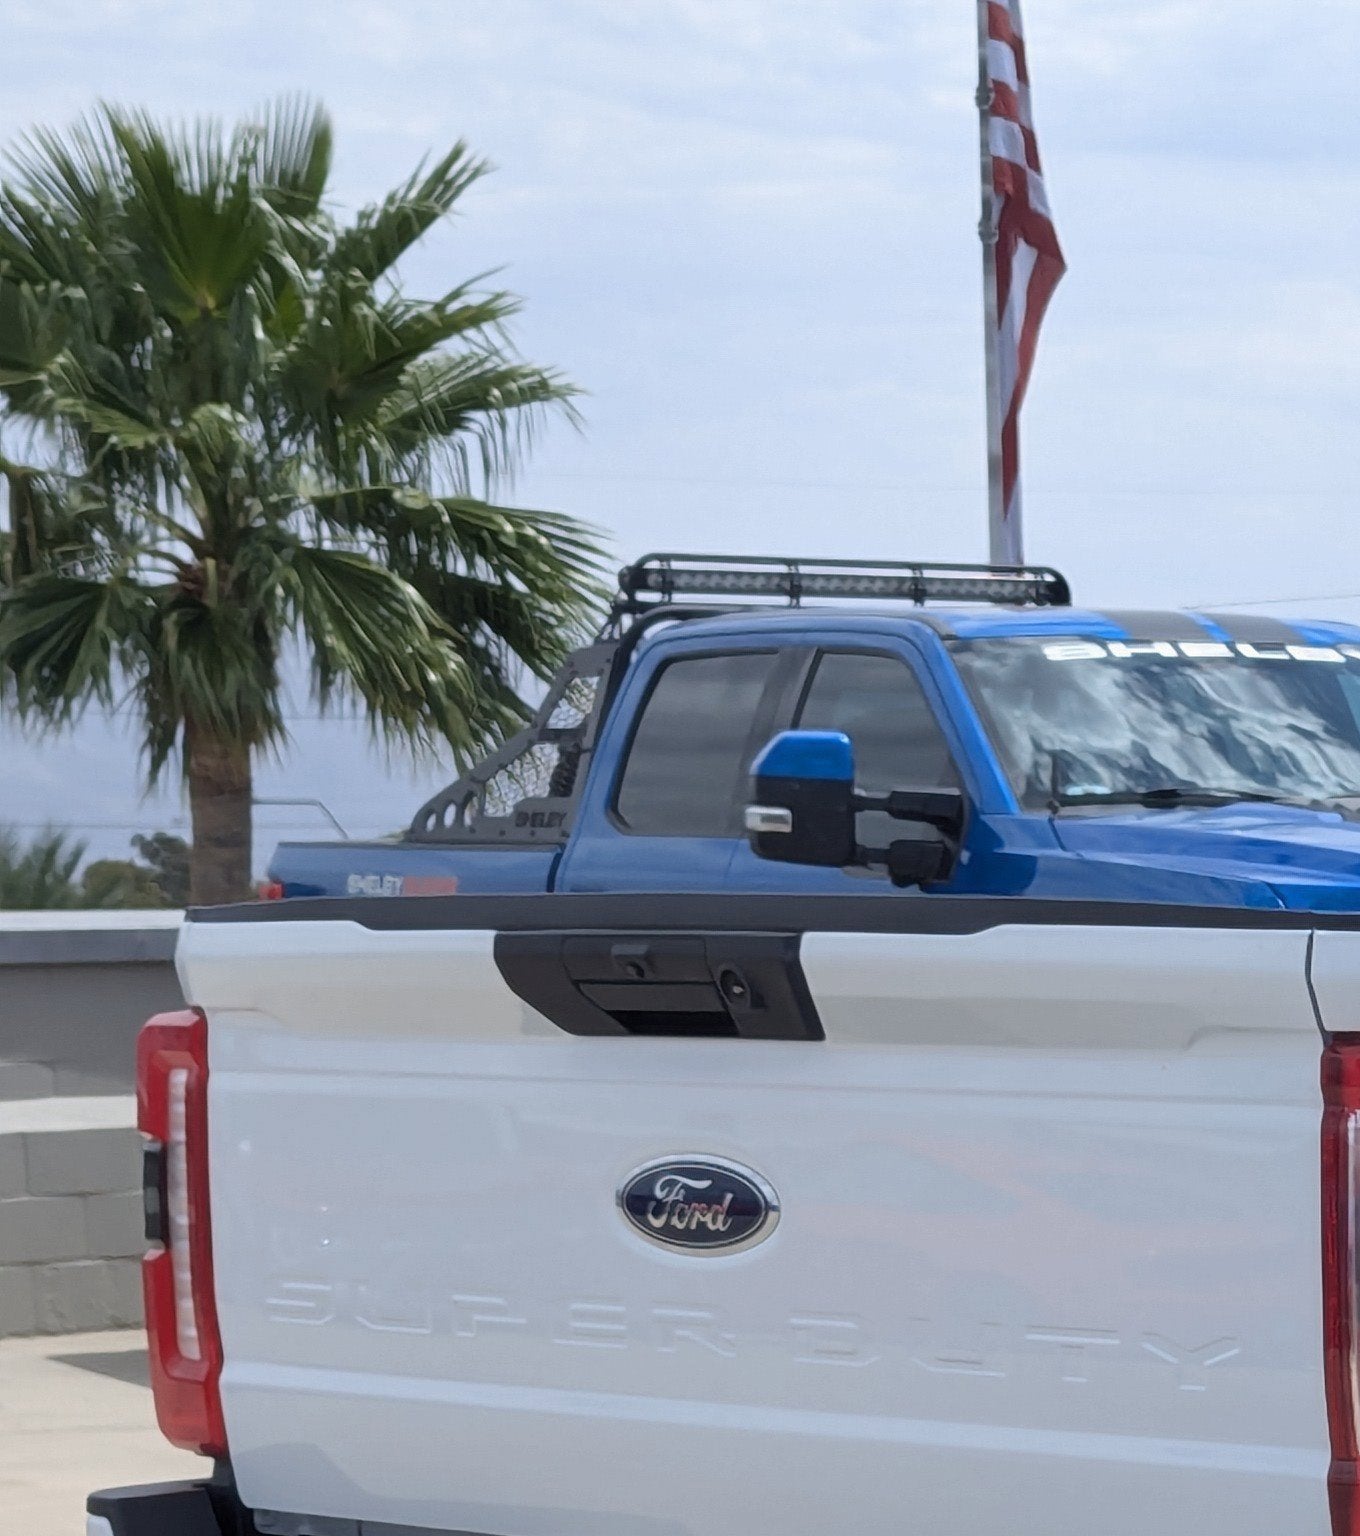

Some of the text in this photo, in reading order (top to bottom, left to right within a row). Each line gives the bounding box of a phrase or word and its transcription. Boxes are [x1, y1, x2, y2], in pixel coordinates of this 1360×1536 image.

[647, 1174, 735, 1232] Ford
[264, 1280, 1241, 1391] SUPER DUTY
